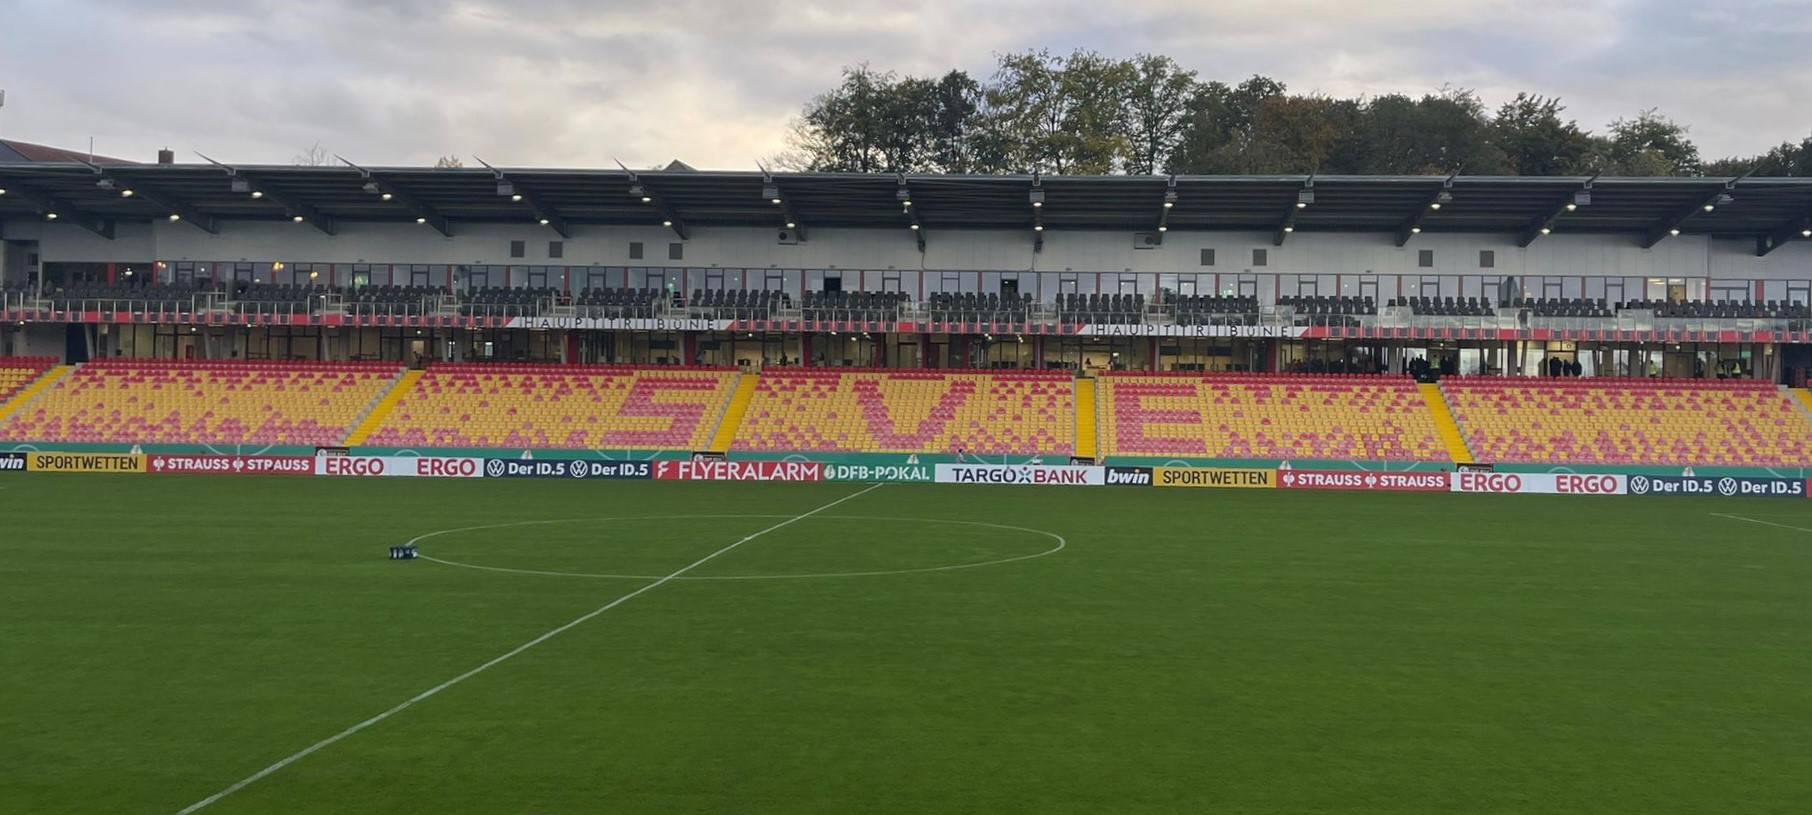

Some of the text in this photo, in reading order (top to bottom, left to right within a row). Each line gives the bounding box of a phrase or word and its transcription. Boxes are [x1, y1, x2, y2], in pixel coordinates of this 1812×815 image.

[0, 454, 25, 469] win
[36, 455, 138, 470] SPORTWETTEN
[167, 458, 230, 470] STRAUSS
[325, 457, 385, 475] ERGO
[416, 458, 476, 476] ERGO
[508, 463, 533, 475] Der
[536, 463, 565, 475] ID.5
[591, 463, 617, 476] Der
[619, 463, 649, 476] ID.5
[678, 461, 819, 481] FLYERALARM
[837, 465, 930, 480] DFB-POKAL
[1106, 468, 1150, 485] bwin
[1162, 470, 1268, 485] SPORTWETTEN
[1298, 474, 1445, 488] STRAUSS STRAUSS
[1460, 473, 1522, 492] ERGO
[1555, 475, 1618, 493] ERGO
[1652, 480, 1679, 492] Der
[1682, 480, 1713, 493] ID.5
[1741, 481, 1767, 493] Der
[1771, 481, 1802, 494] ID.5
